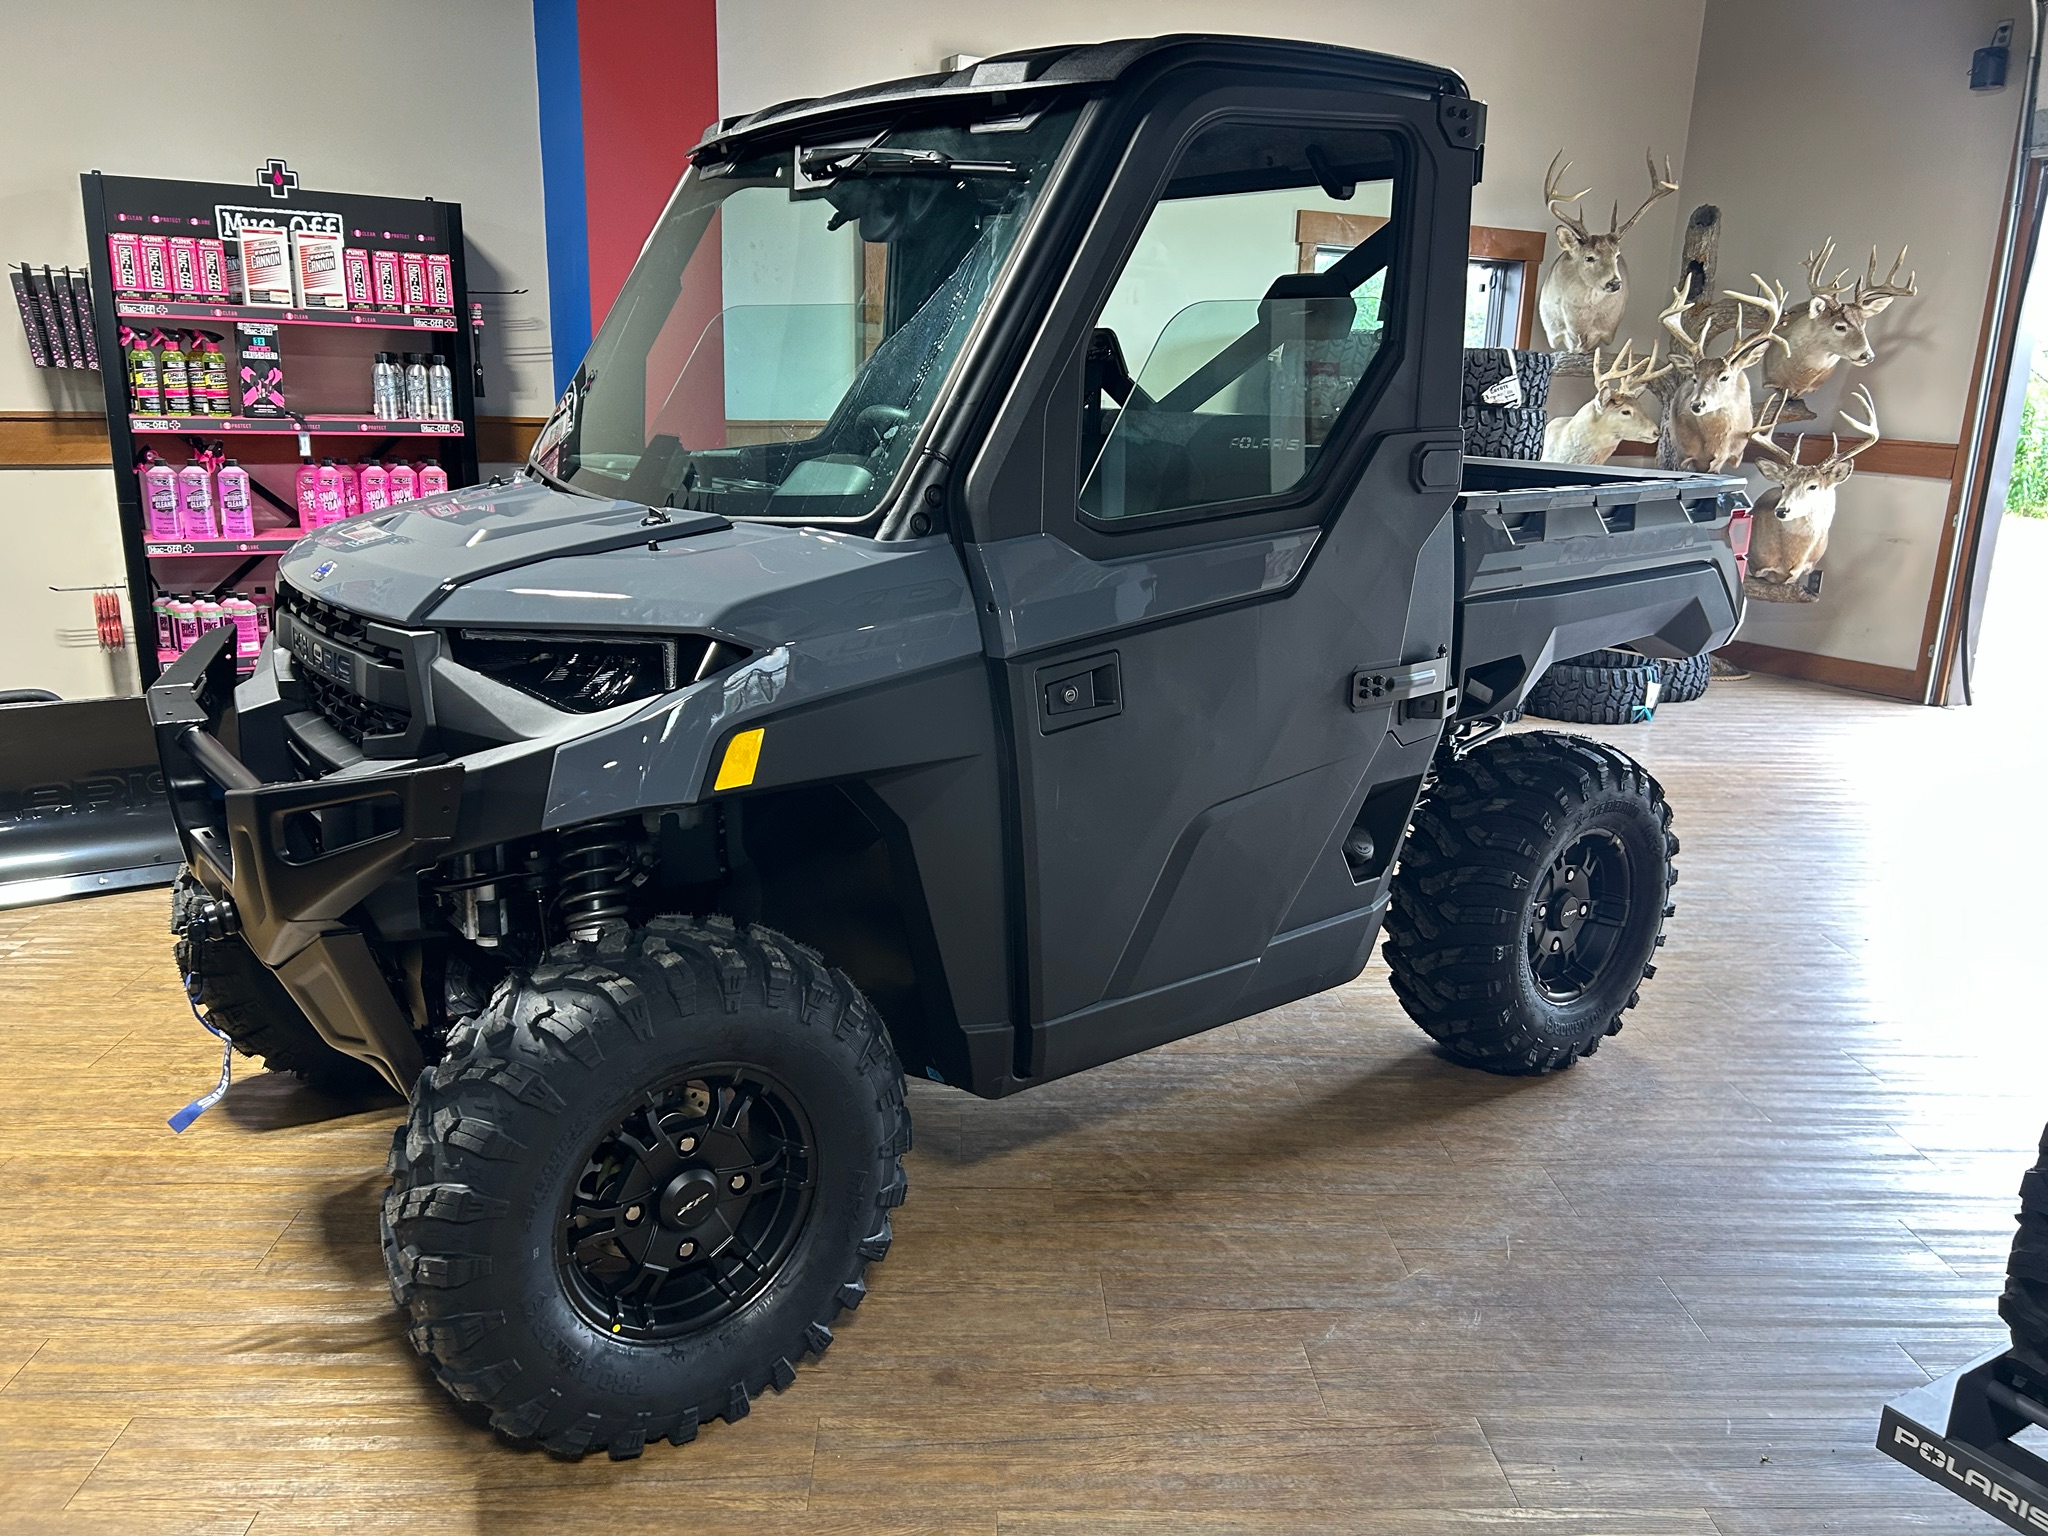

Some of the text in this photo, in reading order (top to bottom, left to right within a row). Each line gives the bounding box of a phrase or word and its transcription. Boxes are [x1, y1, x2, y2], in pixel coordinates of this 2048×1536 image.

[221, 211, 339, 236] MucOff
[254, 247, 279, 256] FOAM
[310, 252, 334, 260] FOAM
[251, 253, 281, 269] CANNON
[306, 257, 335, 273] CANNON
[120, 304, 155, 314] Muc-Off
[133, 420, 168, 429] Muc-Off
[1229, 437, 1300, 451] POLARIS
[181, 622, 196, 631] BIKE
[1894, 1425, 2048, 1534] POLARIS
